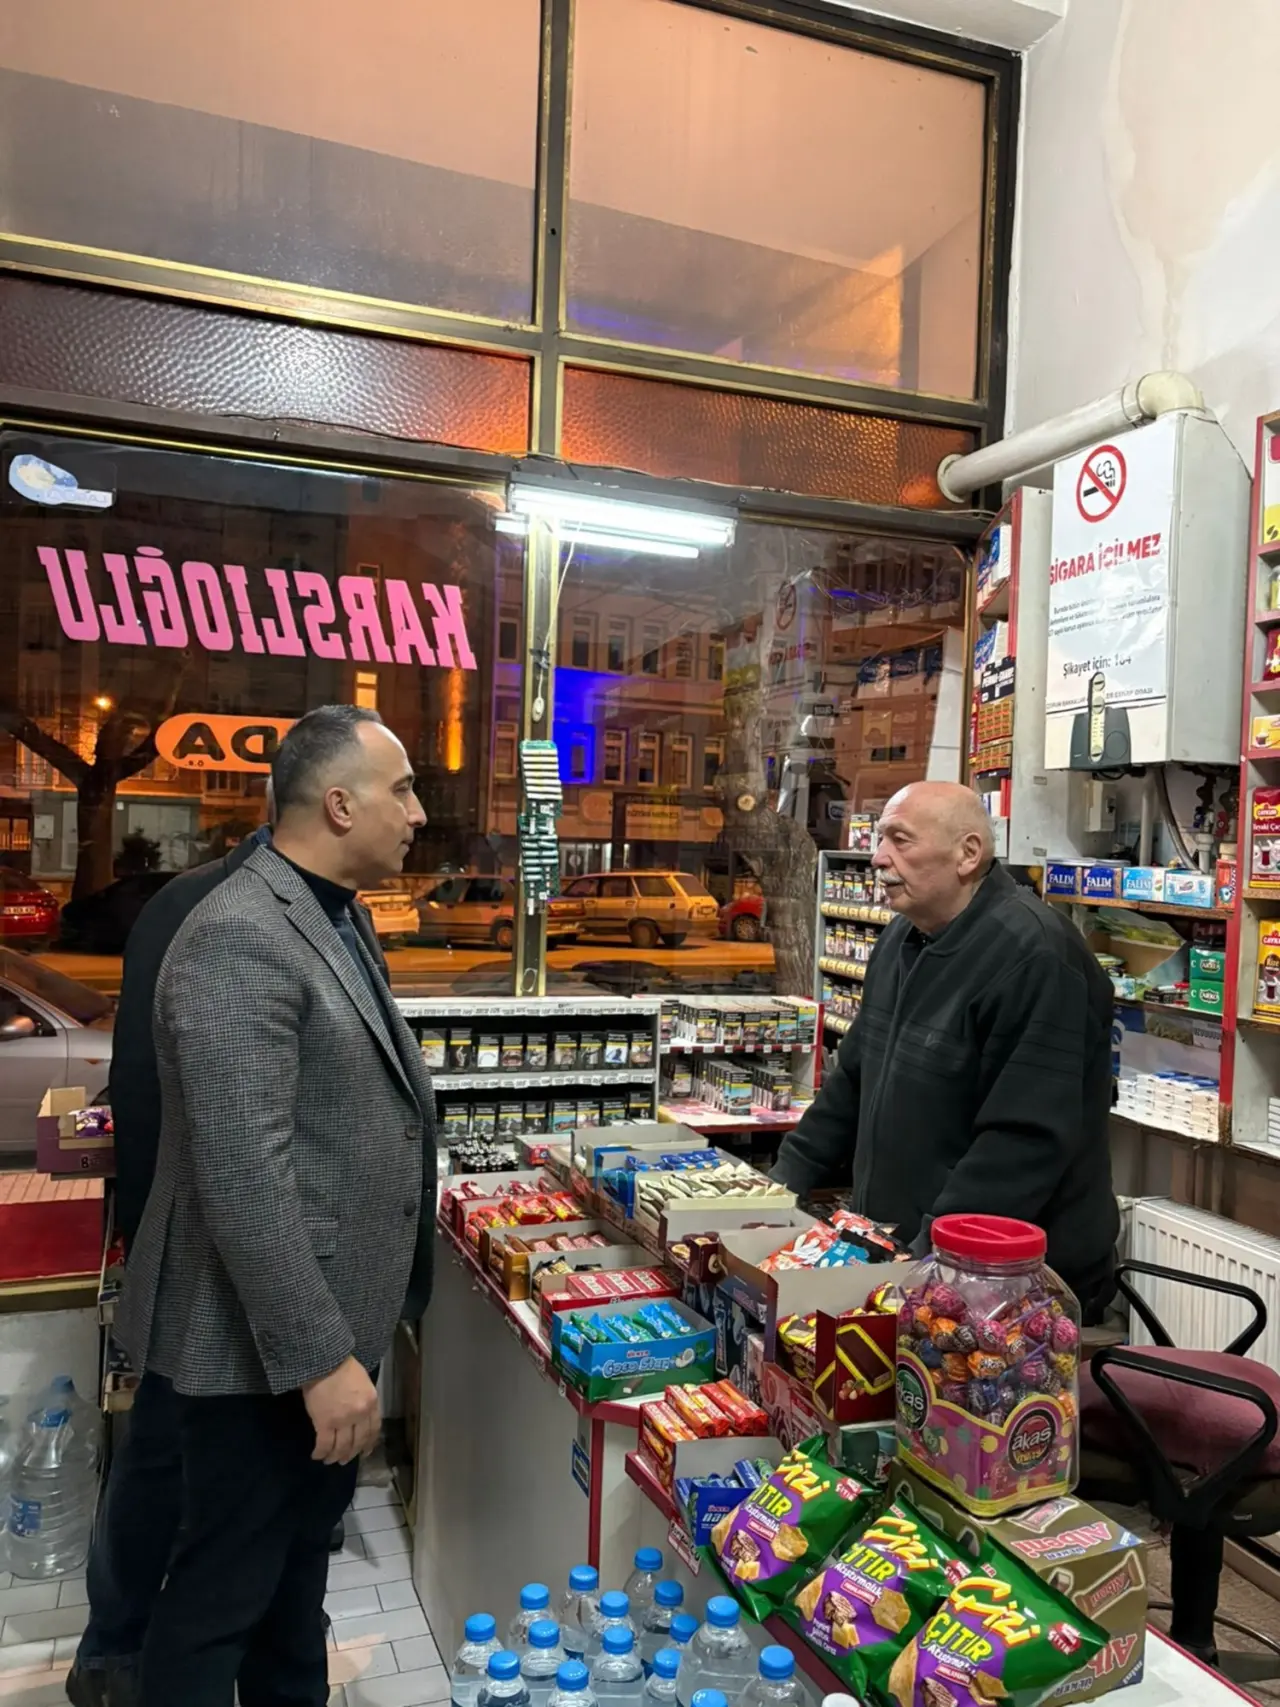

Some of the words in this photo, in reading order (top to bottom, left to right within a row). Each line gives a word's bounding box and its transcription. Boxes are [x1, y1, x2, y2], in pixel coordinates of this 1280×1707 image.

[1049, 552, 1095, 585] SİGARA
[1063, 660, 1091, 679] Şikayet
[1049, 873, 1074, 885] FALIM
[1087, 877, 1112, 888] FALIM
[1126, 879, 1151, 890] FALIM
[1011, 1426, 1052, 1452] akas
[1010, 1520, 1112, 1559] Albeni
[1090, 1571, 1127, 1604] Albeni
[922, 1612, 993, 1662] ÇITIR
